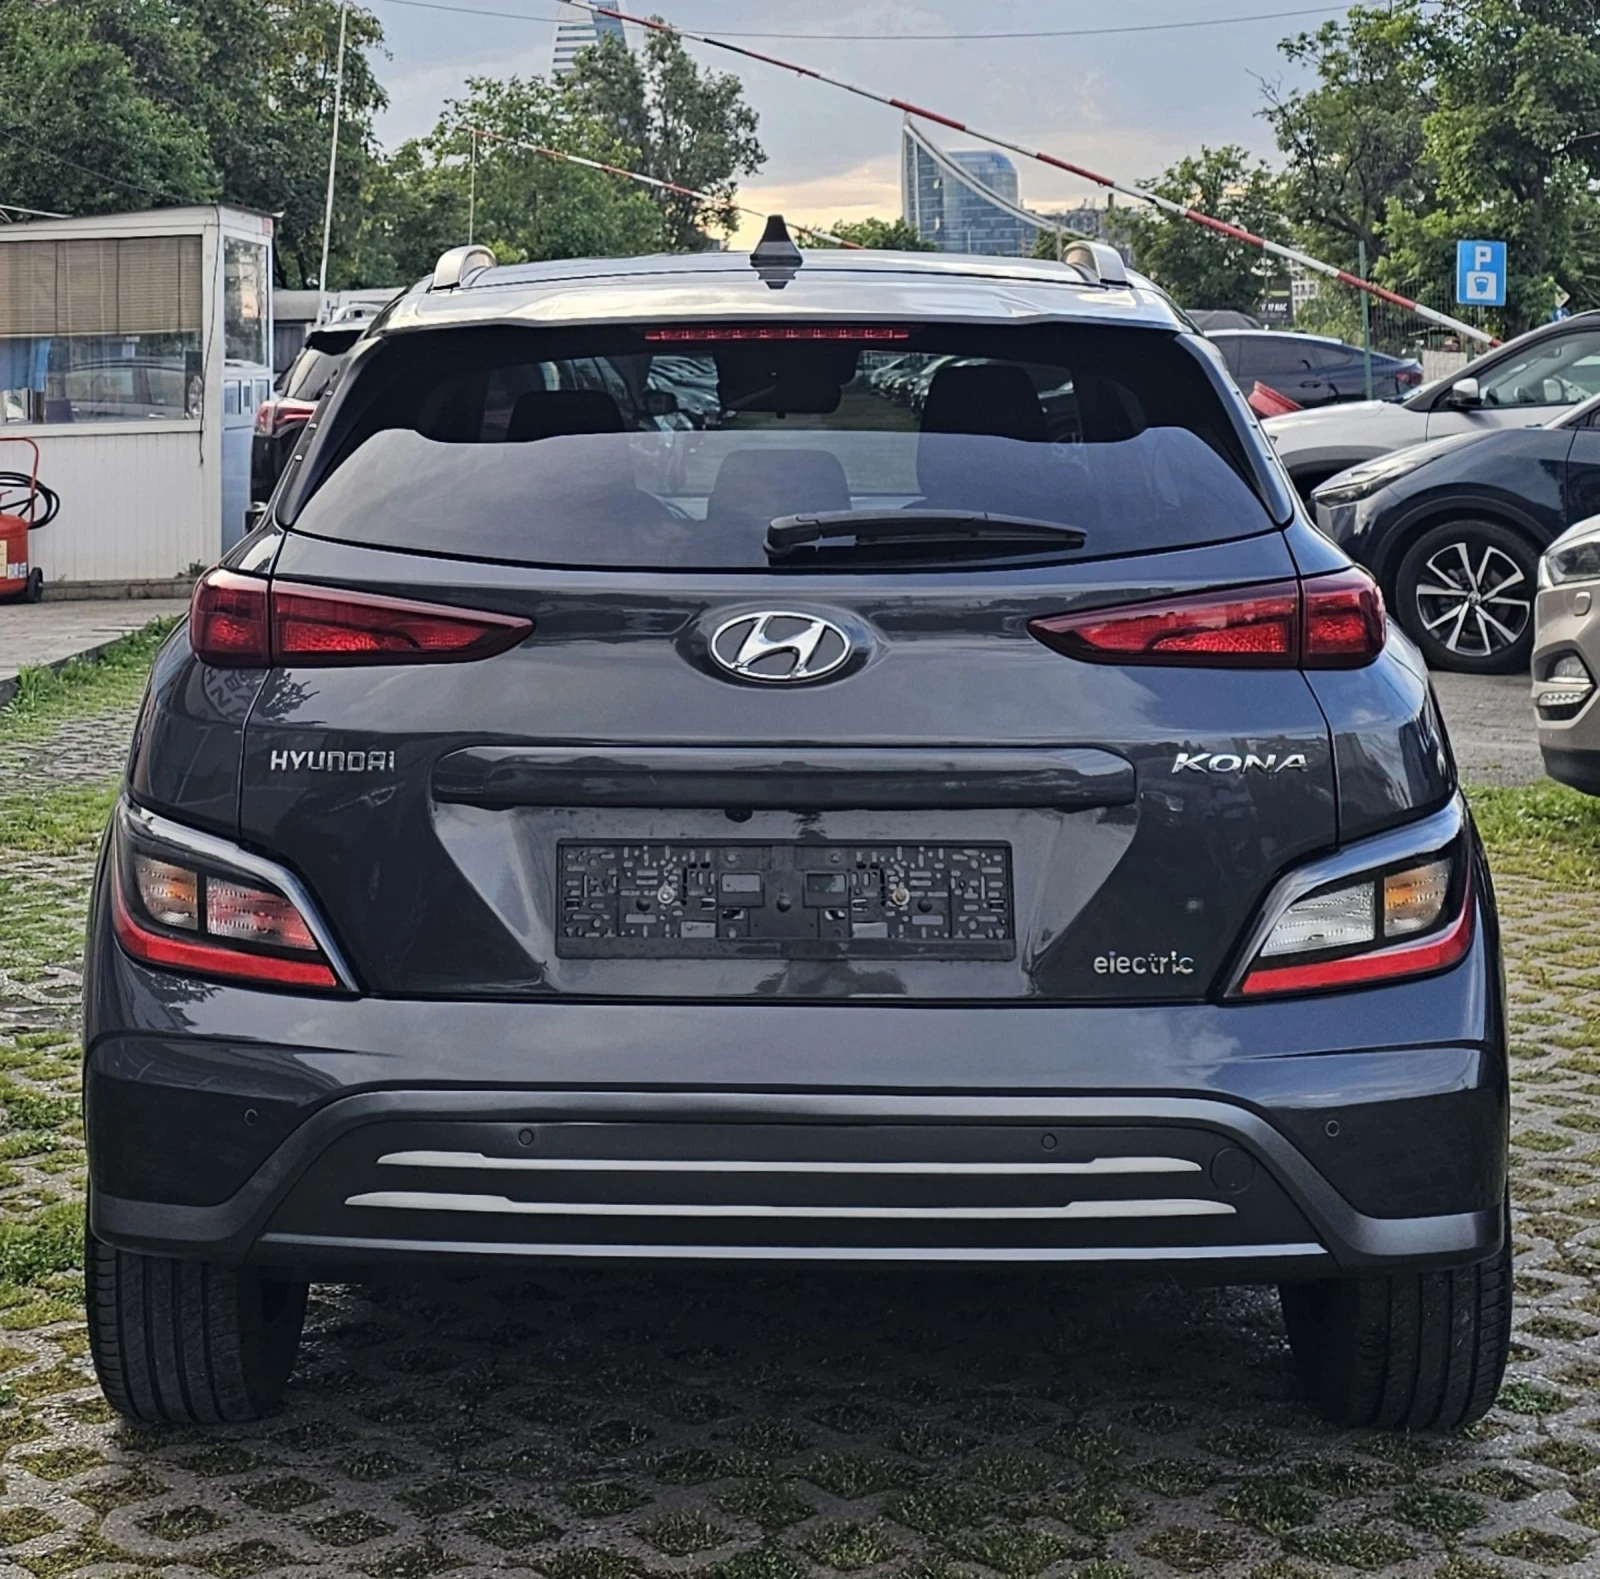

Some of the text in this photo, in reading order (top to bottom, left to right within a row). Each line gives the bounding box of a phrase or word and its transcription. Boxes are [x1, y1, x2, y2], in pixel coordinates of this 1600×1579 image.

[1475, 246, 1492, 270] P
[270, 750, 395, 772] HYUNDAI
[1172, 753, 1307, 773] KONA
[1093, 950, 1194, 974] electric
